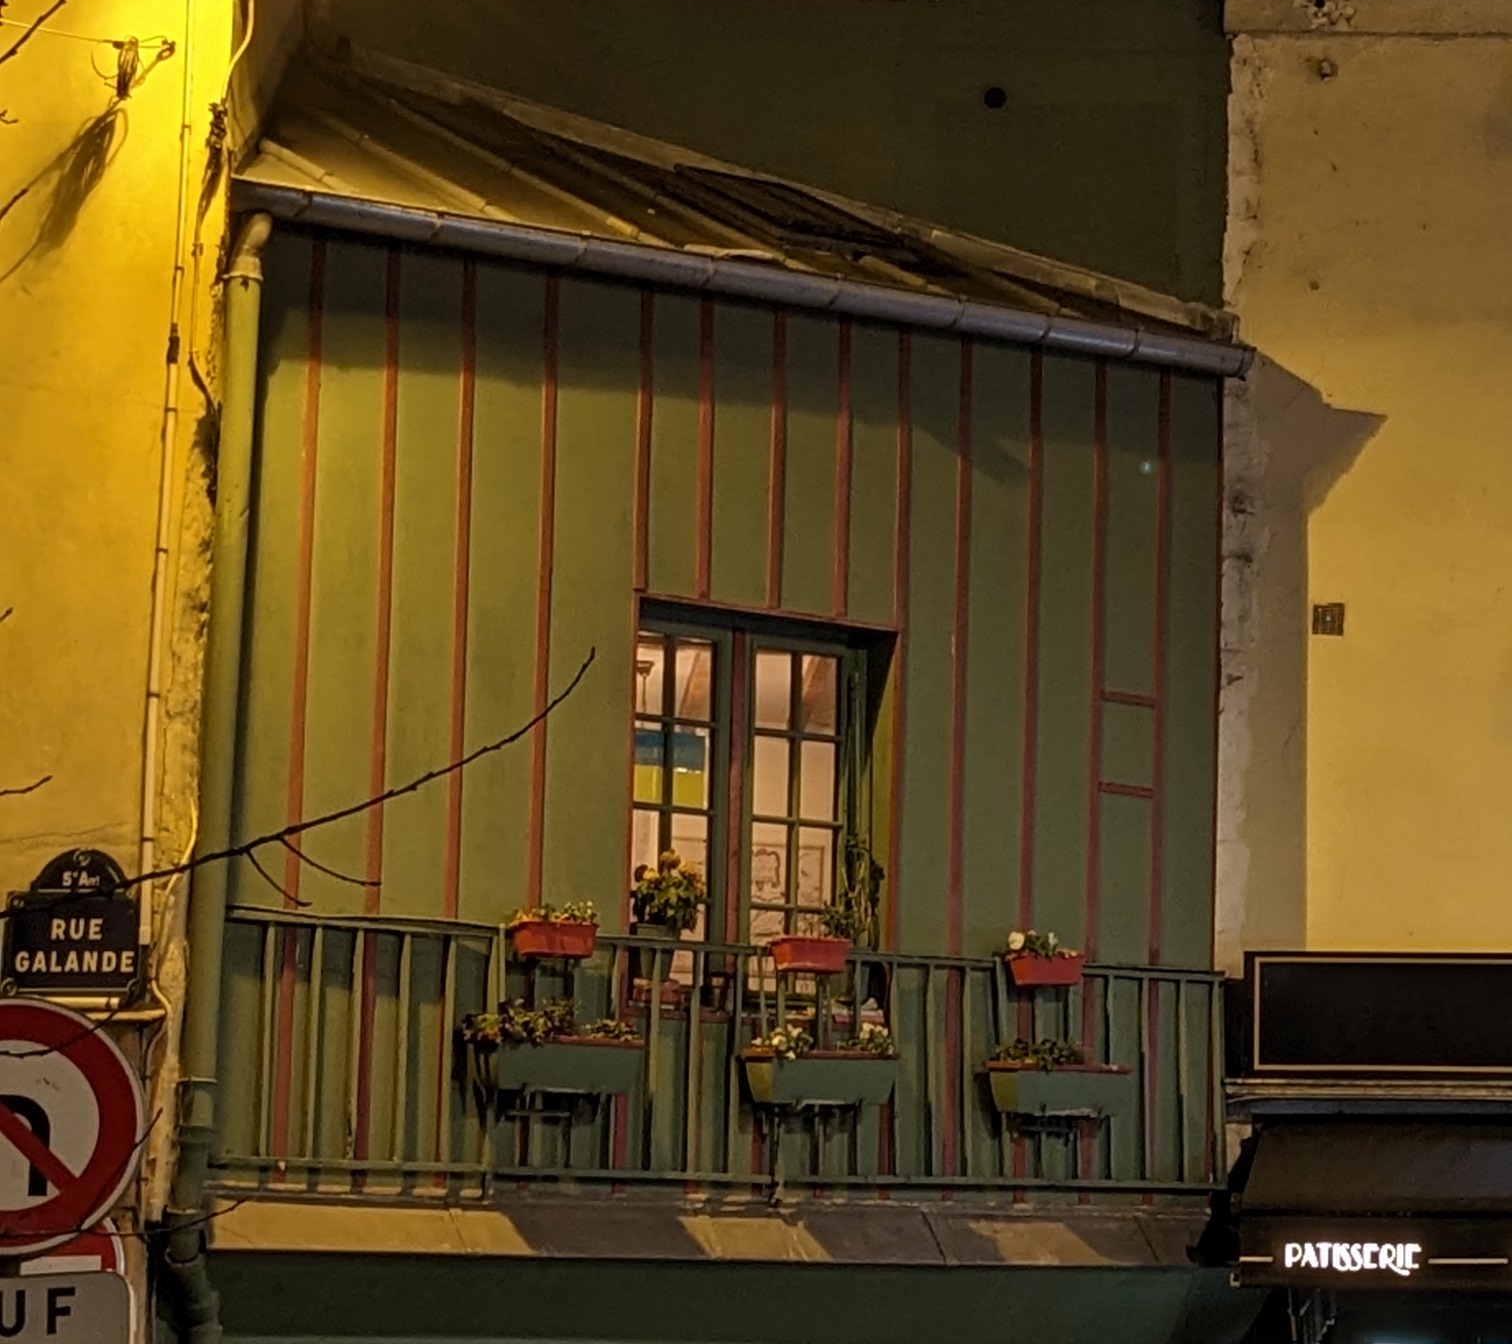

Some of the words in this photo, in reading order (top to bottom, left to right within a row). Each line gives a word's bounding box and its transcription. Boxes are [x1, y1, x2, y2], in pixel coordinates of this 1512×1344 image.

[50, 918, 104, 941] RUE
[15, 951, 136, 973] GALANDE
[1284, 1242, 1422, 1276] PATISSERIE
